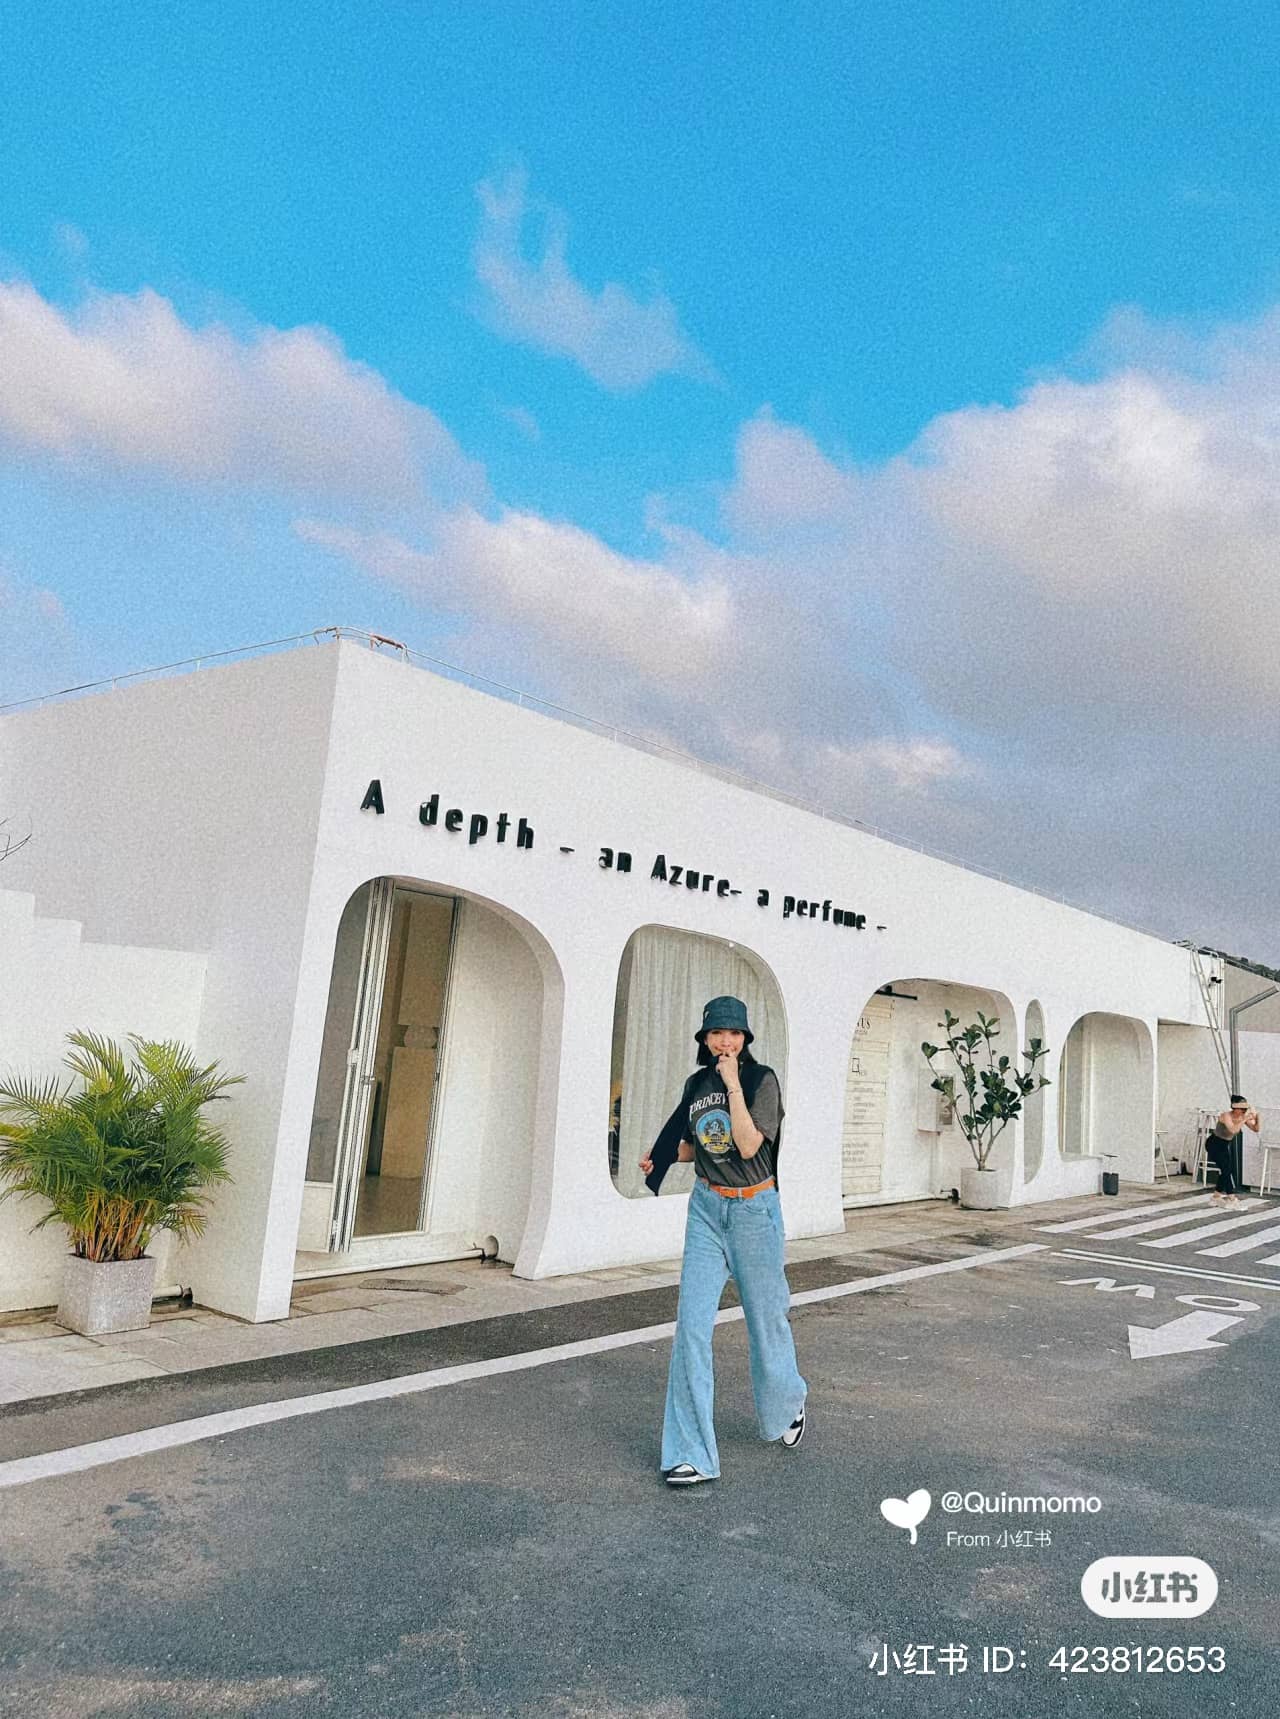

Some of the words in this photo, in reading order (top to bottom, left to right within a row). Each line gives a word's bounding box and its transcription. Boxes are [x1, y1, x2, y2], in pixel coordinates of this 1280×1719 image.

[360, 779, 385, 814] A
[418, 793, 535, 850] depth
[598, 847, 633, 873] an
[756, 888, 770, 907] a
[783, 895, 867, 930] perfume
